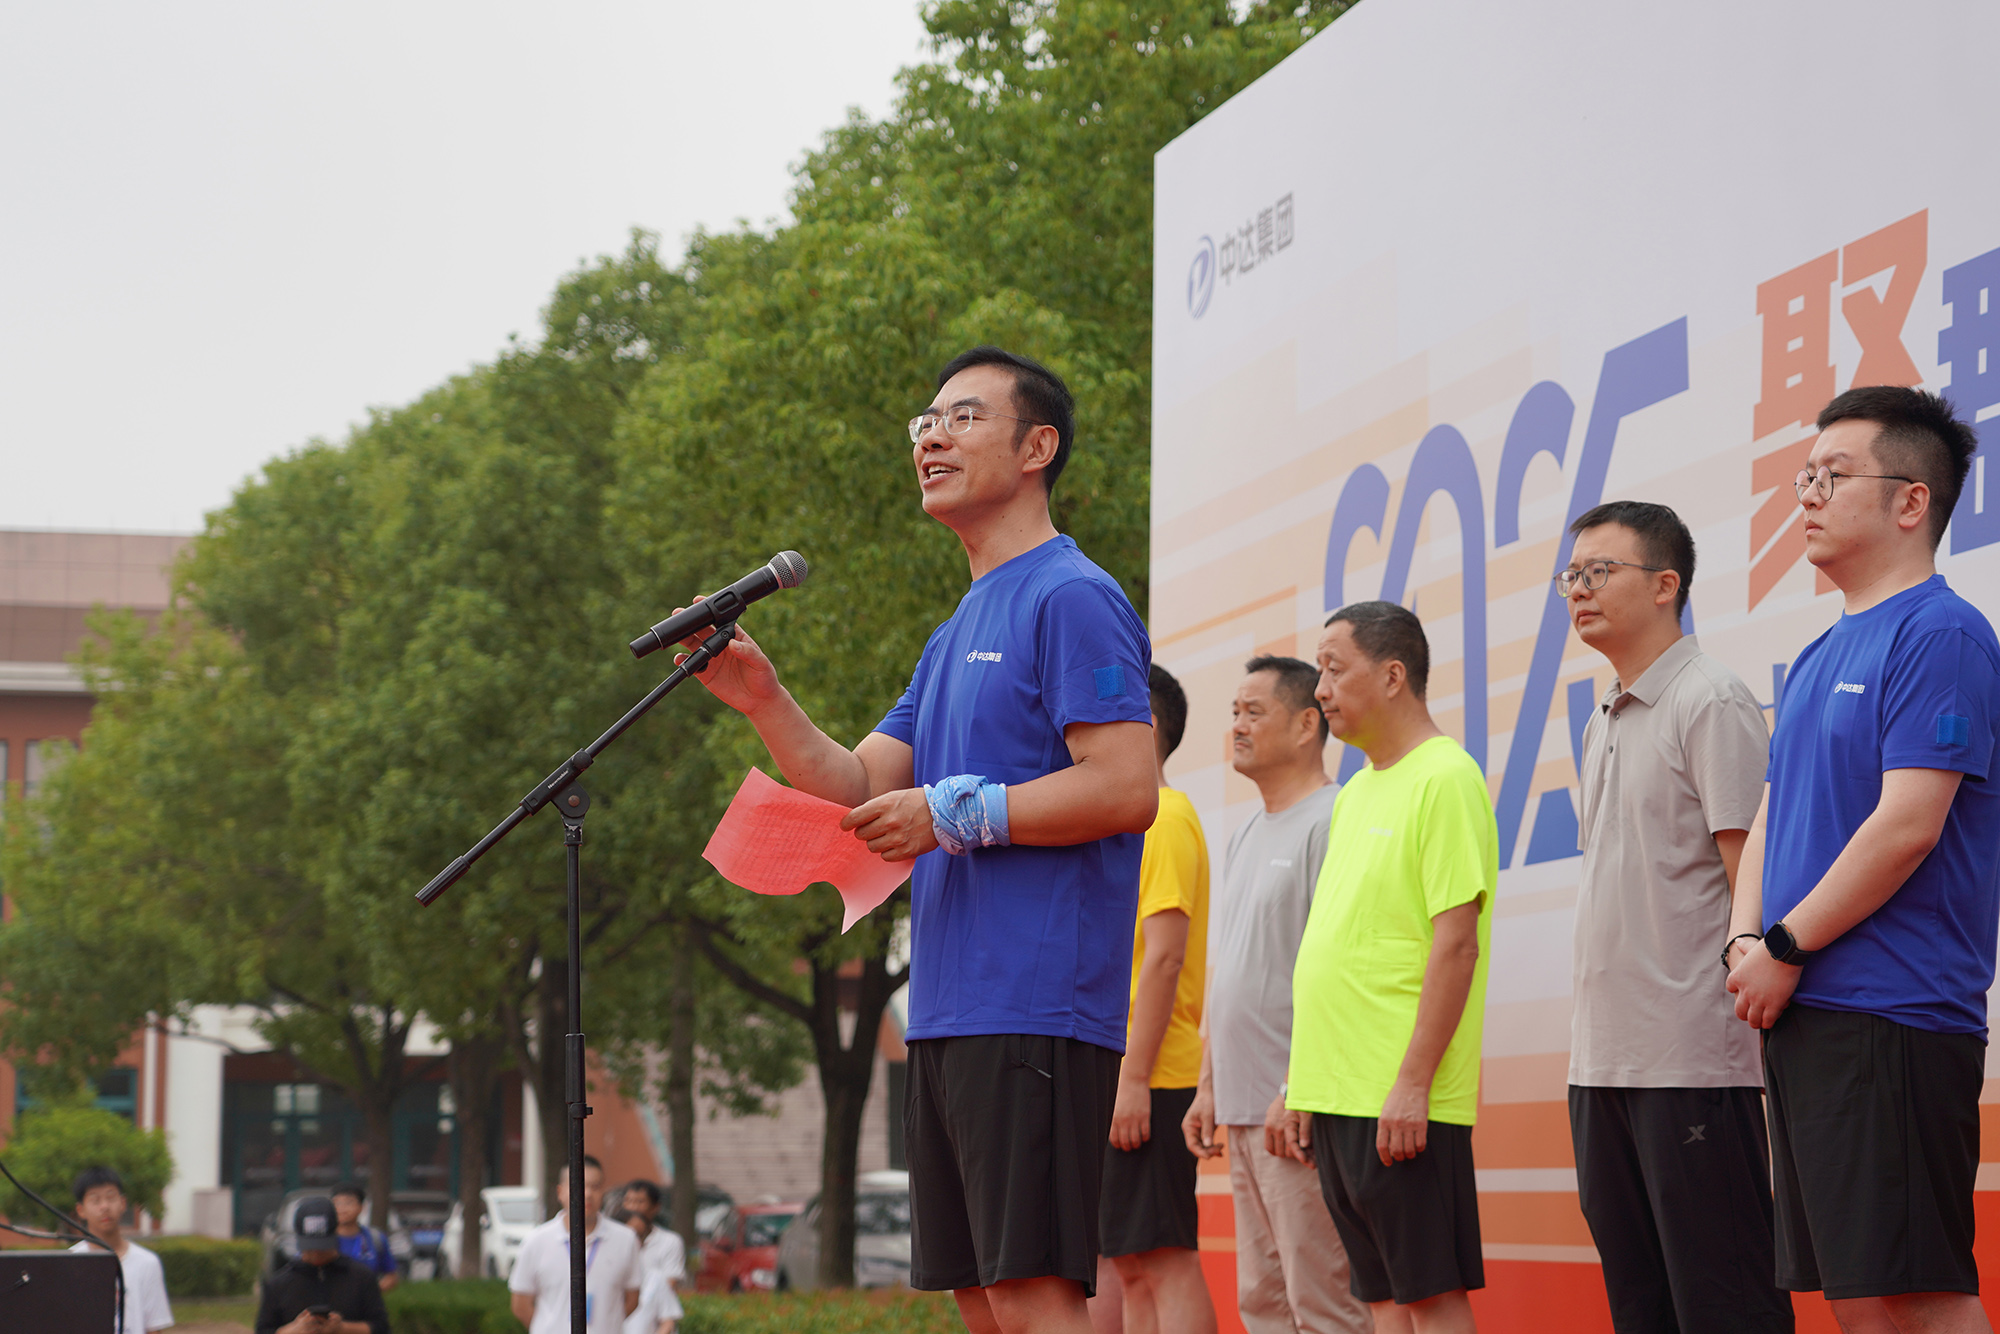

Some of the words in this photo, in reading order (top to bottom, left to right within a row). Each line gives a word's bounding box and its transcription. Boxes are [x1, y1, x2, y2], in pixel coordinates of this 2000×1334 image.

[1219, 192, 1293, 287] 中达集团
[977, 652, 1002, 662] 中达集团
